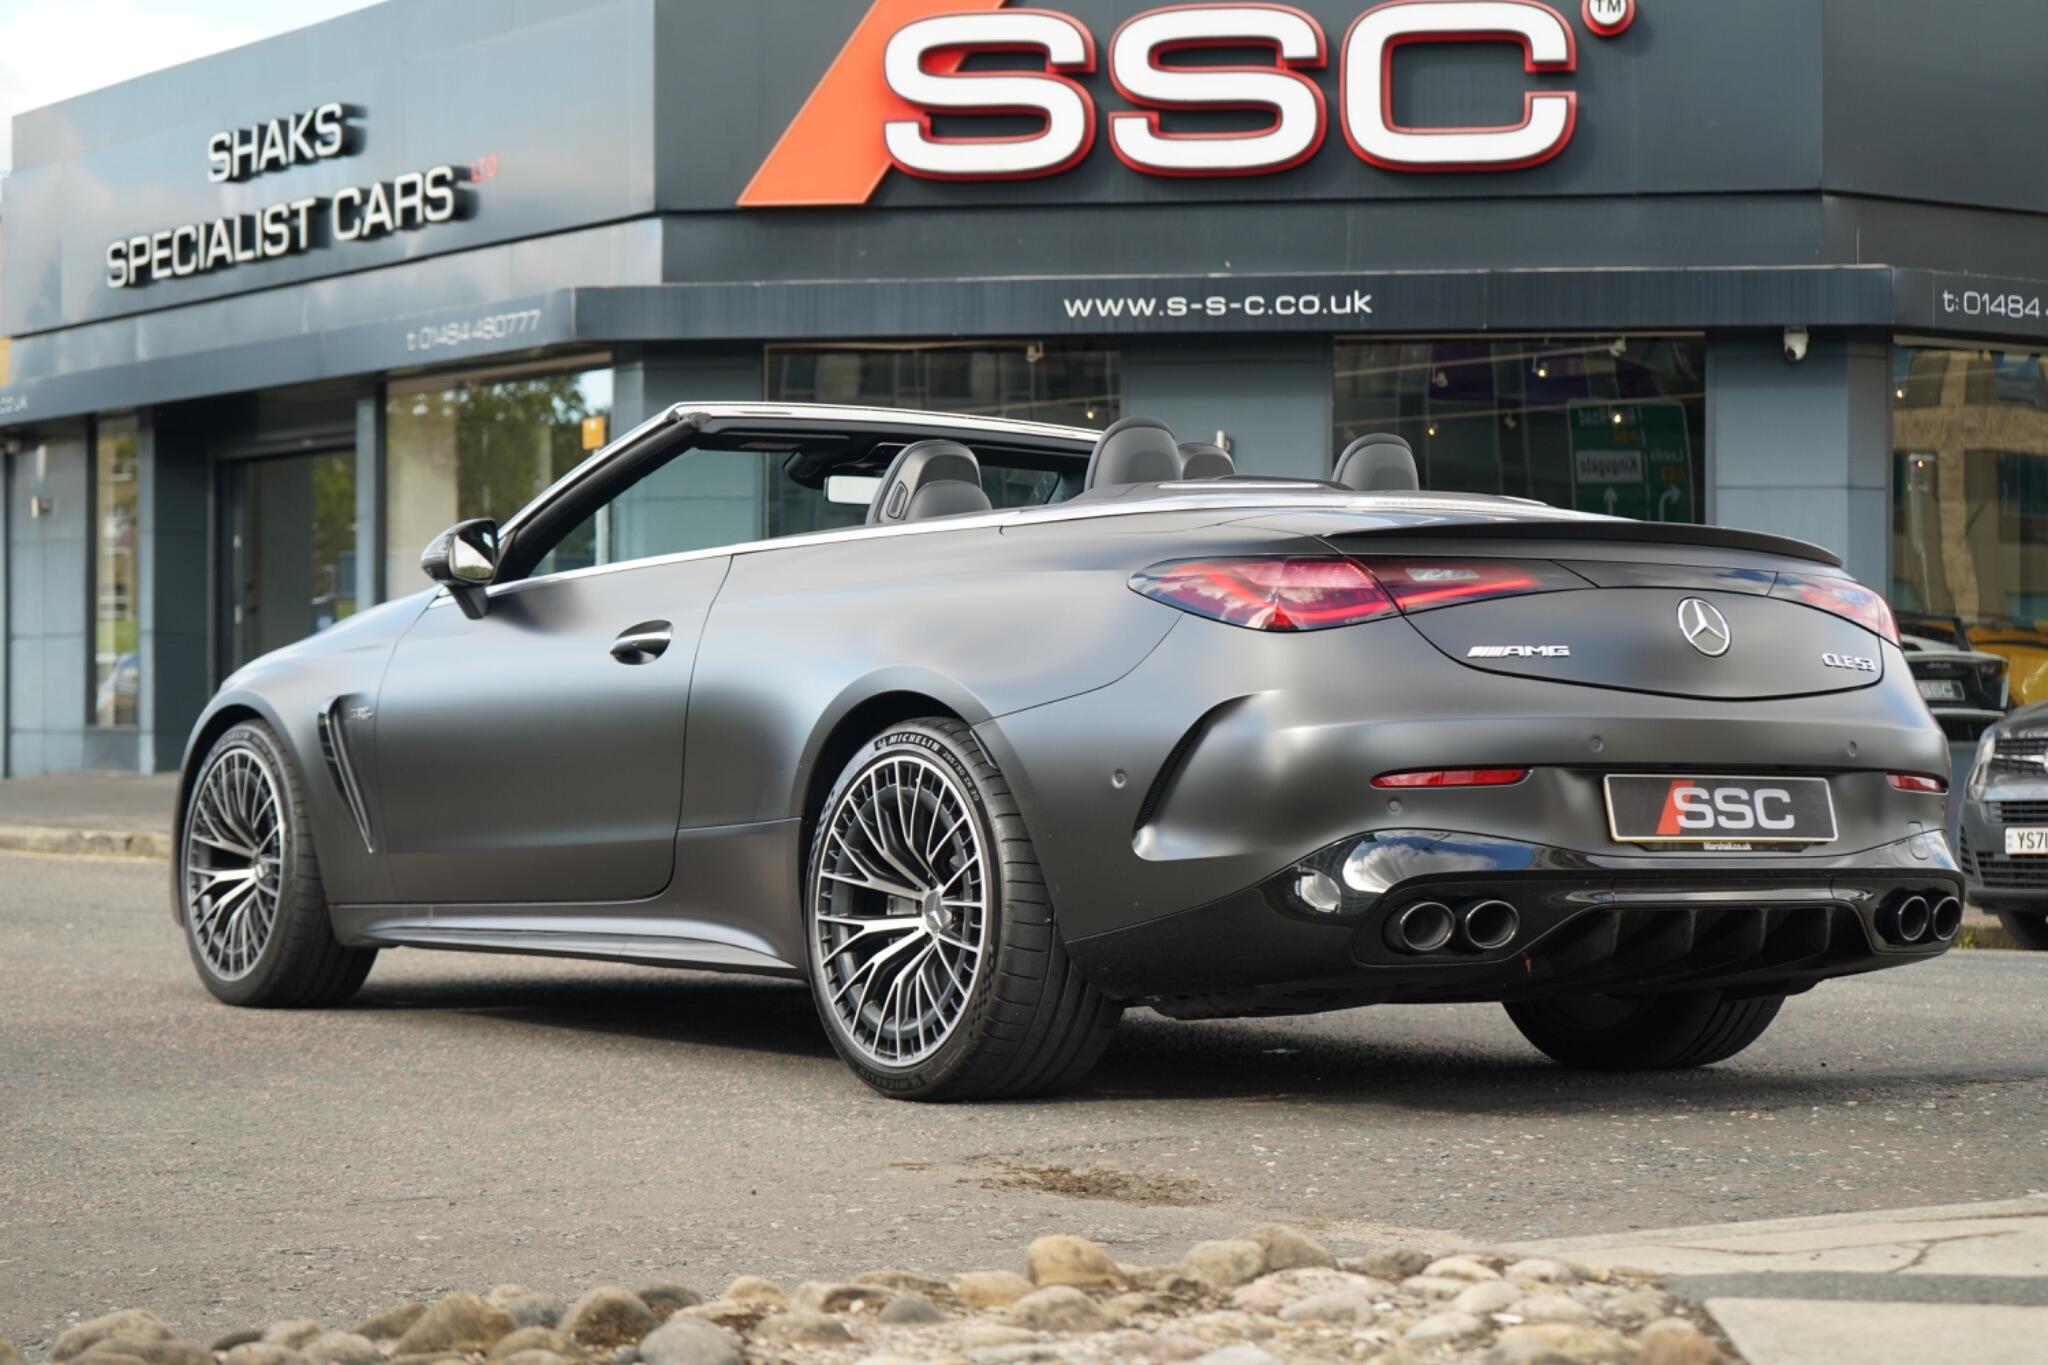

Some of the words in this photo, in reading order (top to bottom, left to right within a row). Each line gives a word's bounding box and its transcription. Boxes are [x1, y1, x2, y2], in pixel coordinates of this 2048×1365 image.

[1595, 0, 1621, 13] TM
[883, 1, 1577, 181] SSC
[206, 101, 343, 184] SHAKS
[105, 196, 317, 289] SPECIALIST
[331, 165, 454, 242] CARS
[1063, 289, 1373, 318] www.s-s-c.co.uk
[1503, 645, 1570, 658] AMG
[888, 733, 941, 752] MICHELIN
[1673, 787, 1796, 829] SSC
